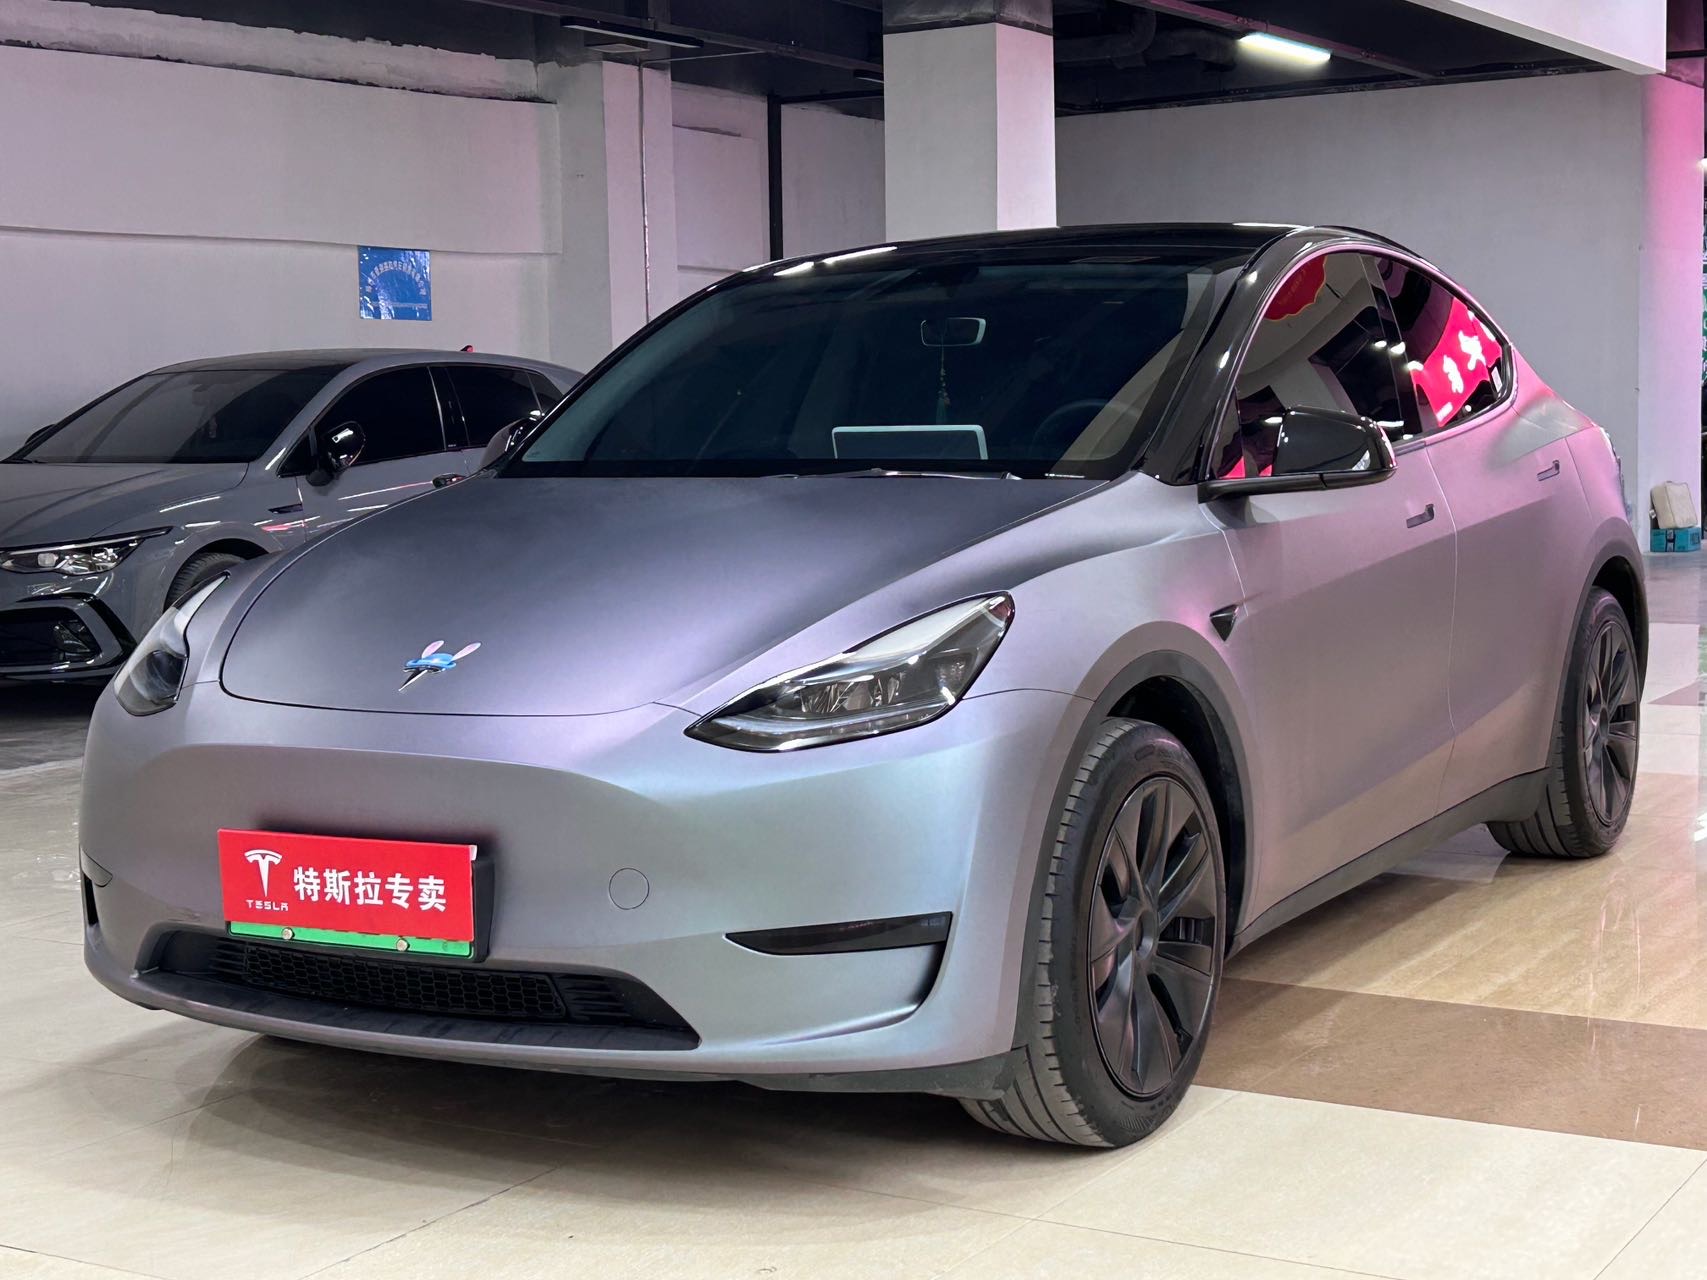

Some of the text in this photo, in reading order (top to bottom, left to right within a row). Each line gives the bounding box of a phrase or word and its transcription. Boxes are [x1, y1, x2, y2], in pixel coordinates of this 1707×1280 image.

[293, 866, 447, 912] 特斯拉专卖
[246, 899, 289, 912] TESLA
